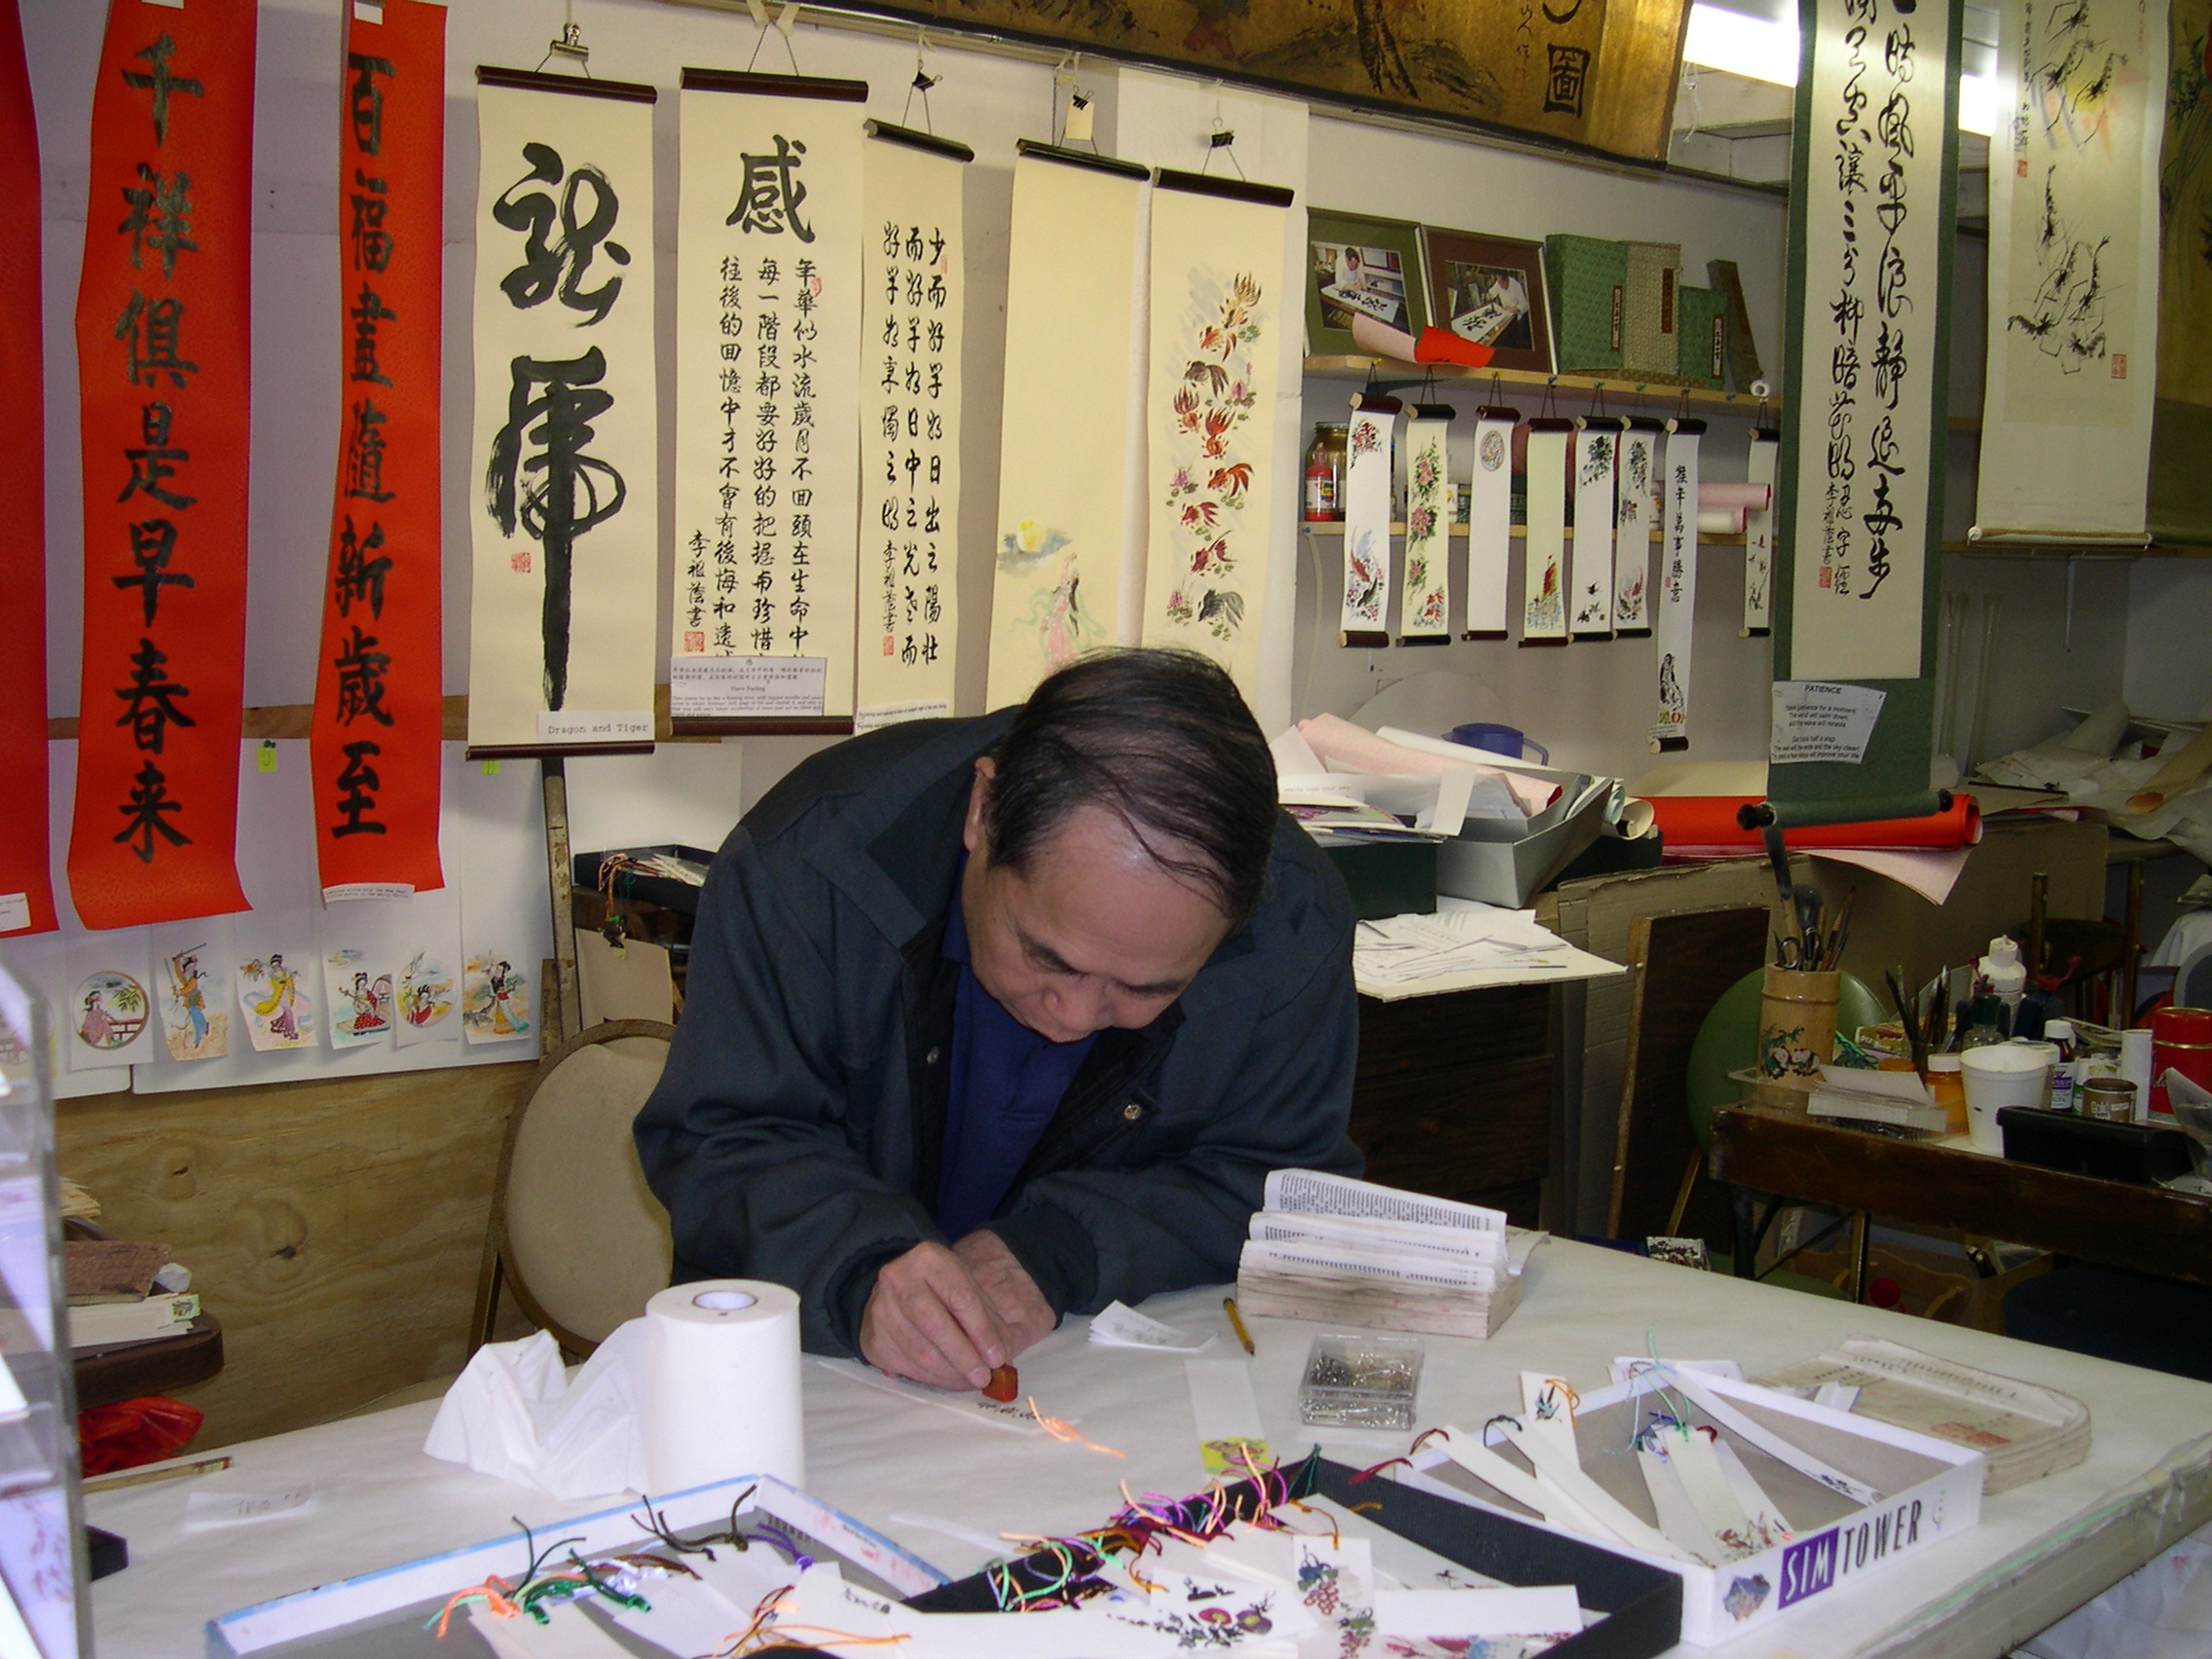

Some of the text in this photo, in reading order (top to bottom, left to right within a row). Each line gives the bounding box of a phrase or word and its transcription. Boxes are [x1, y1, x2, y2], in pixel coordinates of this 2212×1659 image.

[725, 134, 816, 243] 感
[1804, 684, 1842, 694] PATIENCE
[548, 723, 648, 734] Dragon and Tiger
